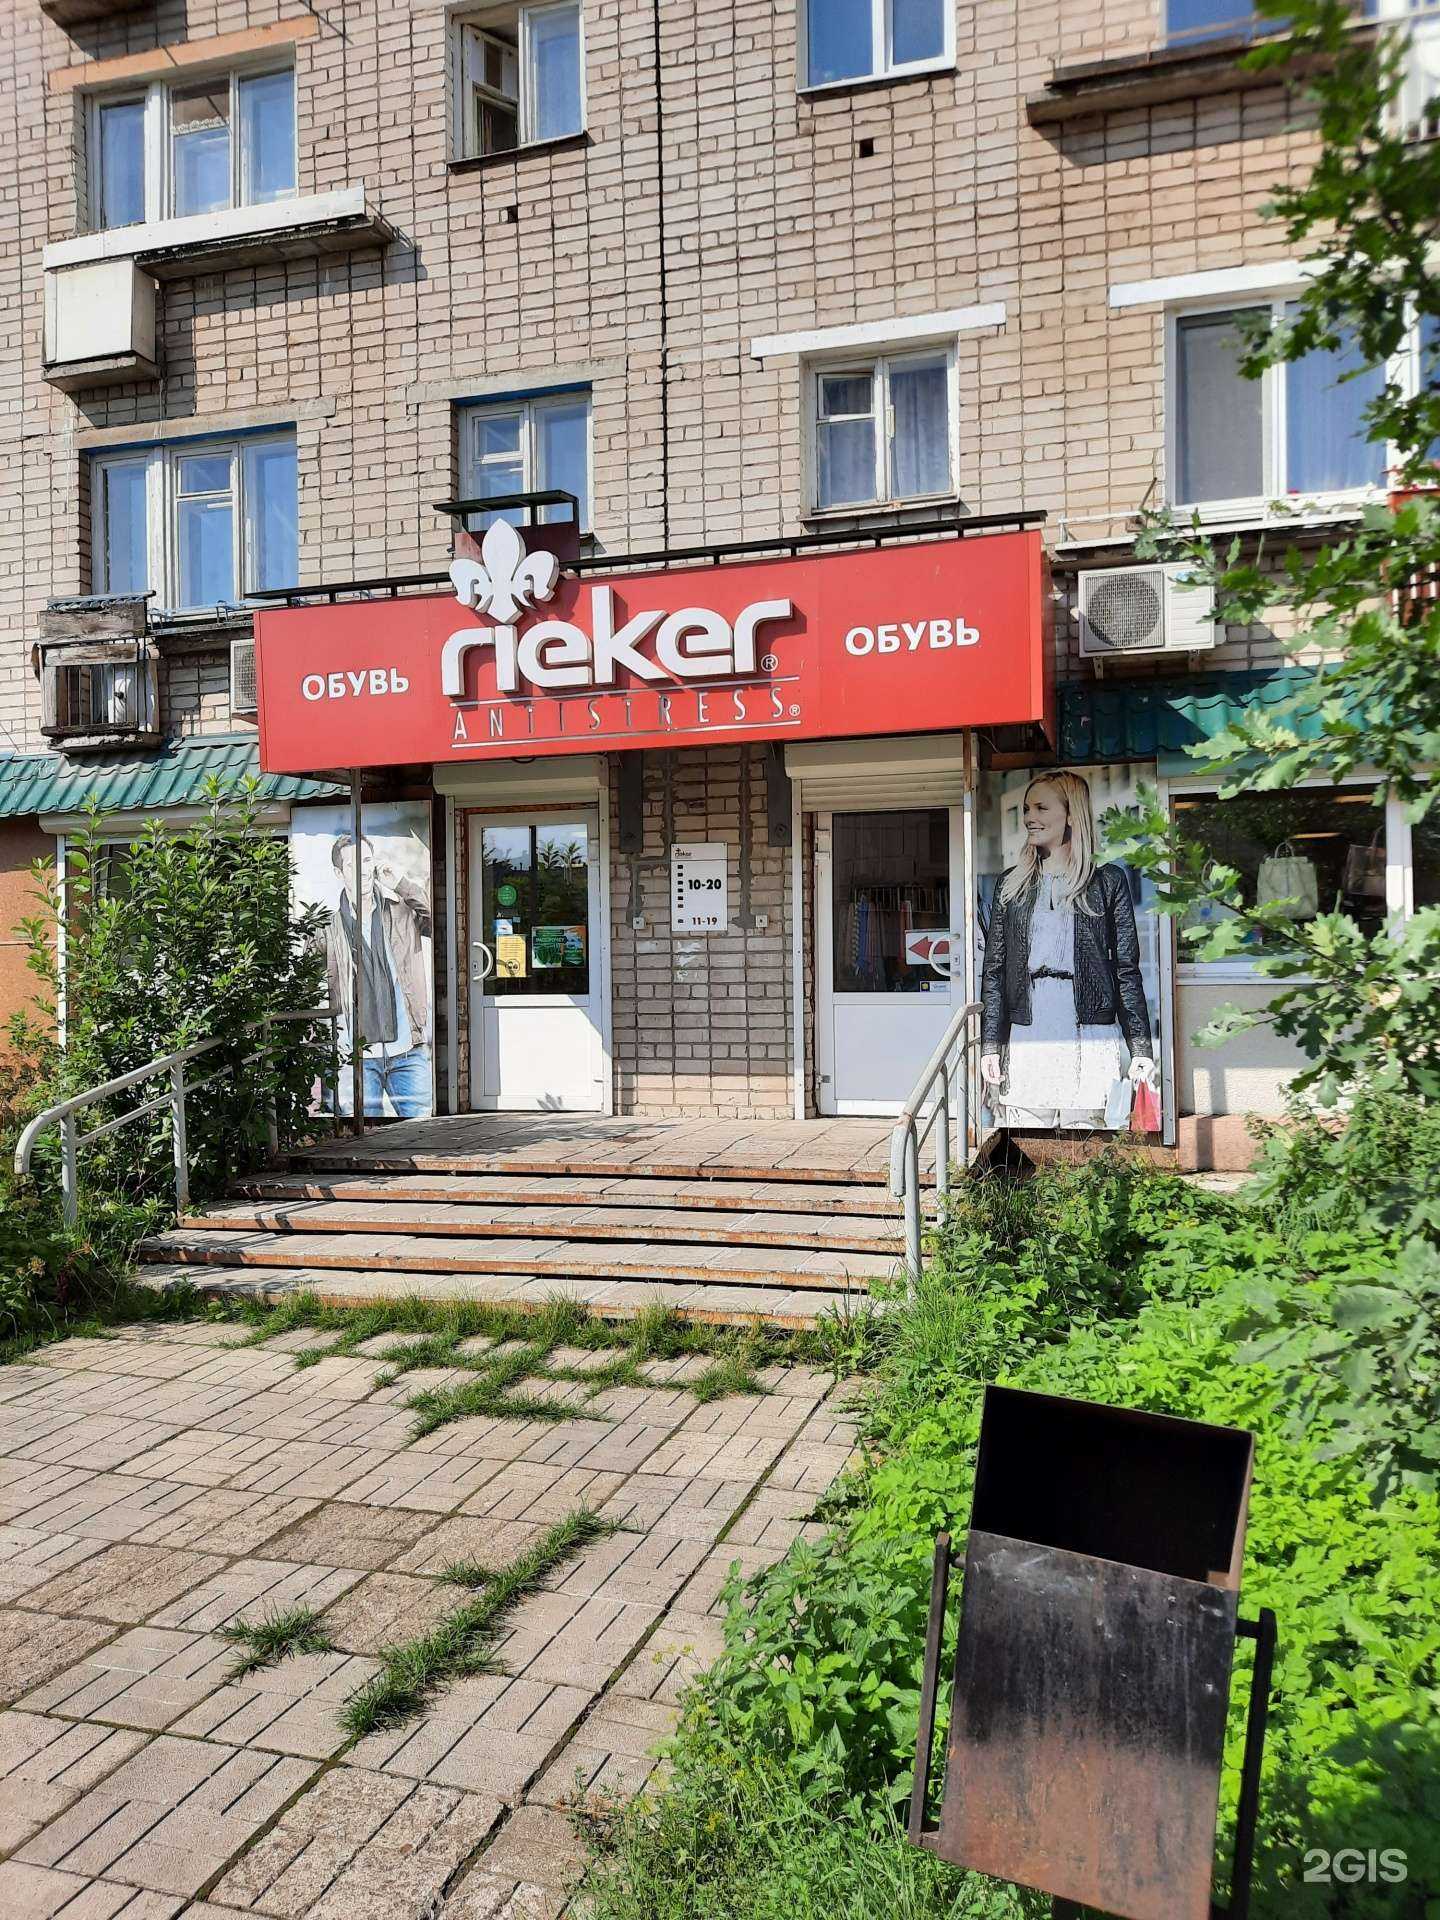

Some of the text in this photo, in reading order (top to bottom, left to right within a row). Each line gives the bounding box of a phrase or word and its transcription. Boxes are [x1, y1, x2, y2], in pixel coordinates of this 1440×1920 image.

[441, 585, 794, 696] rieker
[845, 617, 980, 656] ОБУВЬ
[302, 667, 410, 701] ОБУВЬ
[688, 879, 722, 890] 10-20
[692, 917, 718, 925] 11-19
